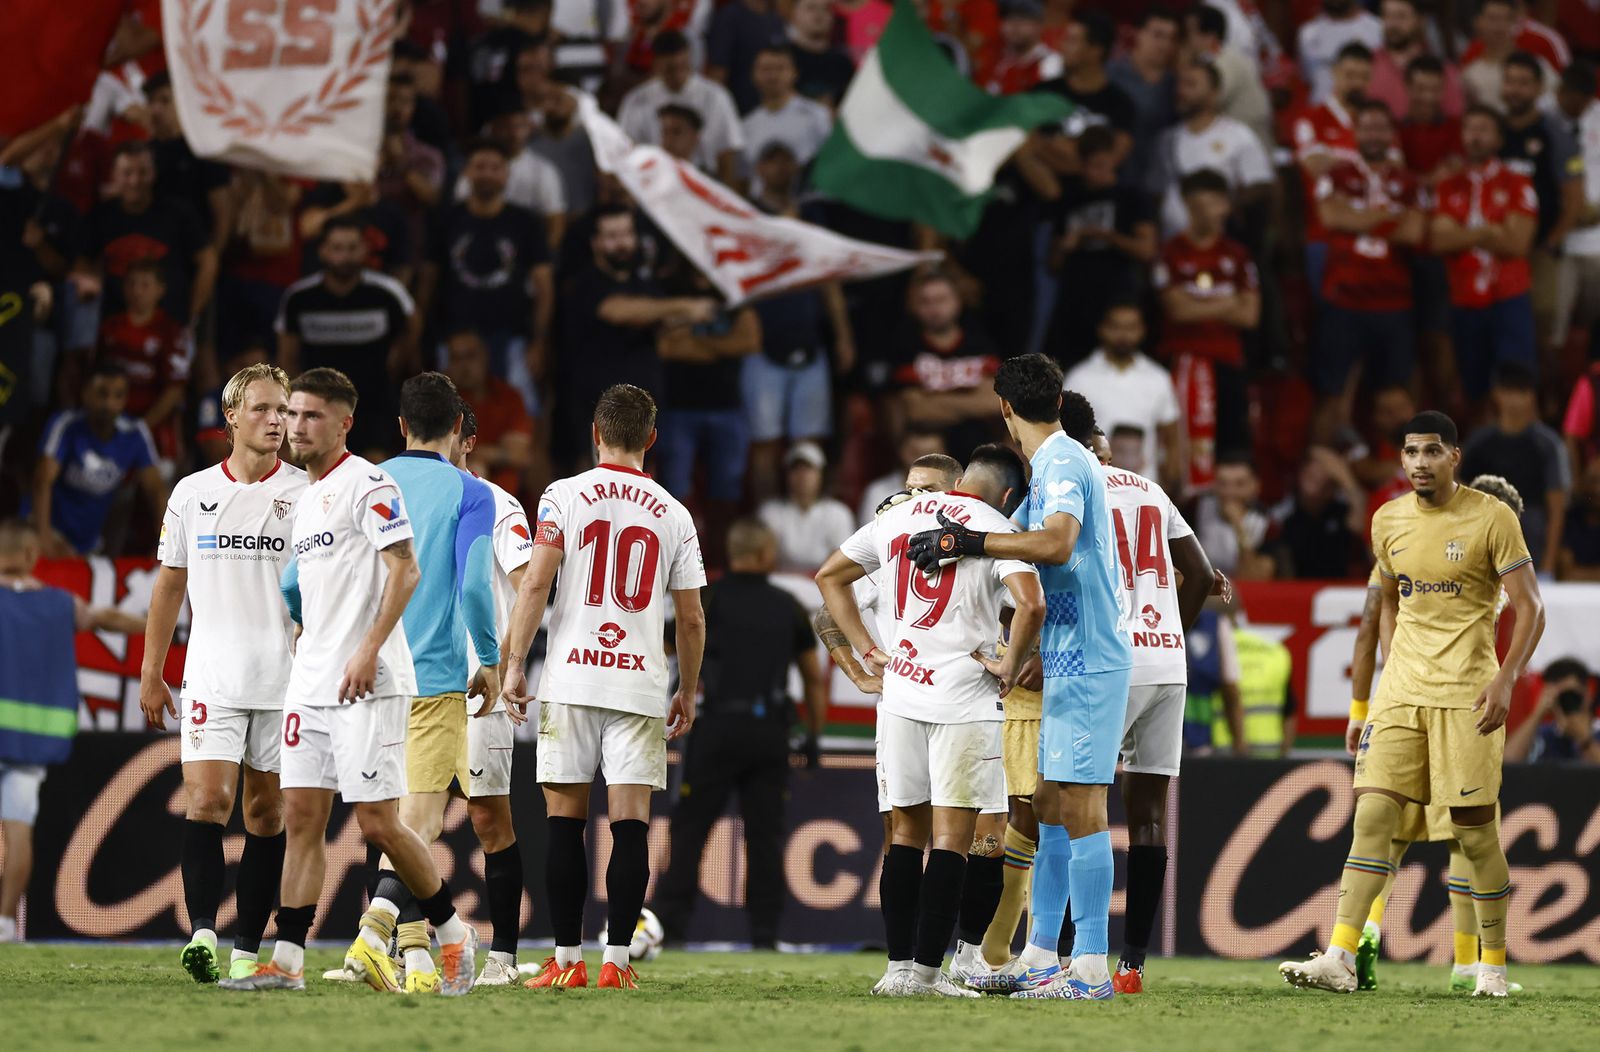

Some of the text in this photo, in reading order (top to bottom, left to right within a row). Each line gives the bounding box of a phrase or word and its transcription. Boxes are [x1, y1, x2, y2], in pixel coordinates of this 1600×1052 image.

[580, 482, 668, 518] I.RAKITIĆ
[219, 535, 285, 552] DEGIRO
[1112, 505, 1169, 590] 14
[579, 519, 660, 613] 10
[888, 533, 958, 630] 19
[1414, 580, 1463, 596] Spotify
[1130, 631, 1184, 650] NDEX
[566, 647, 646, 672] ANDEX
[191, 700, 208, 725] 5
